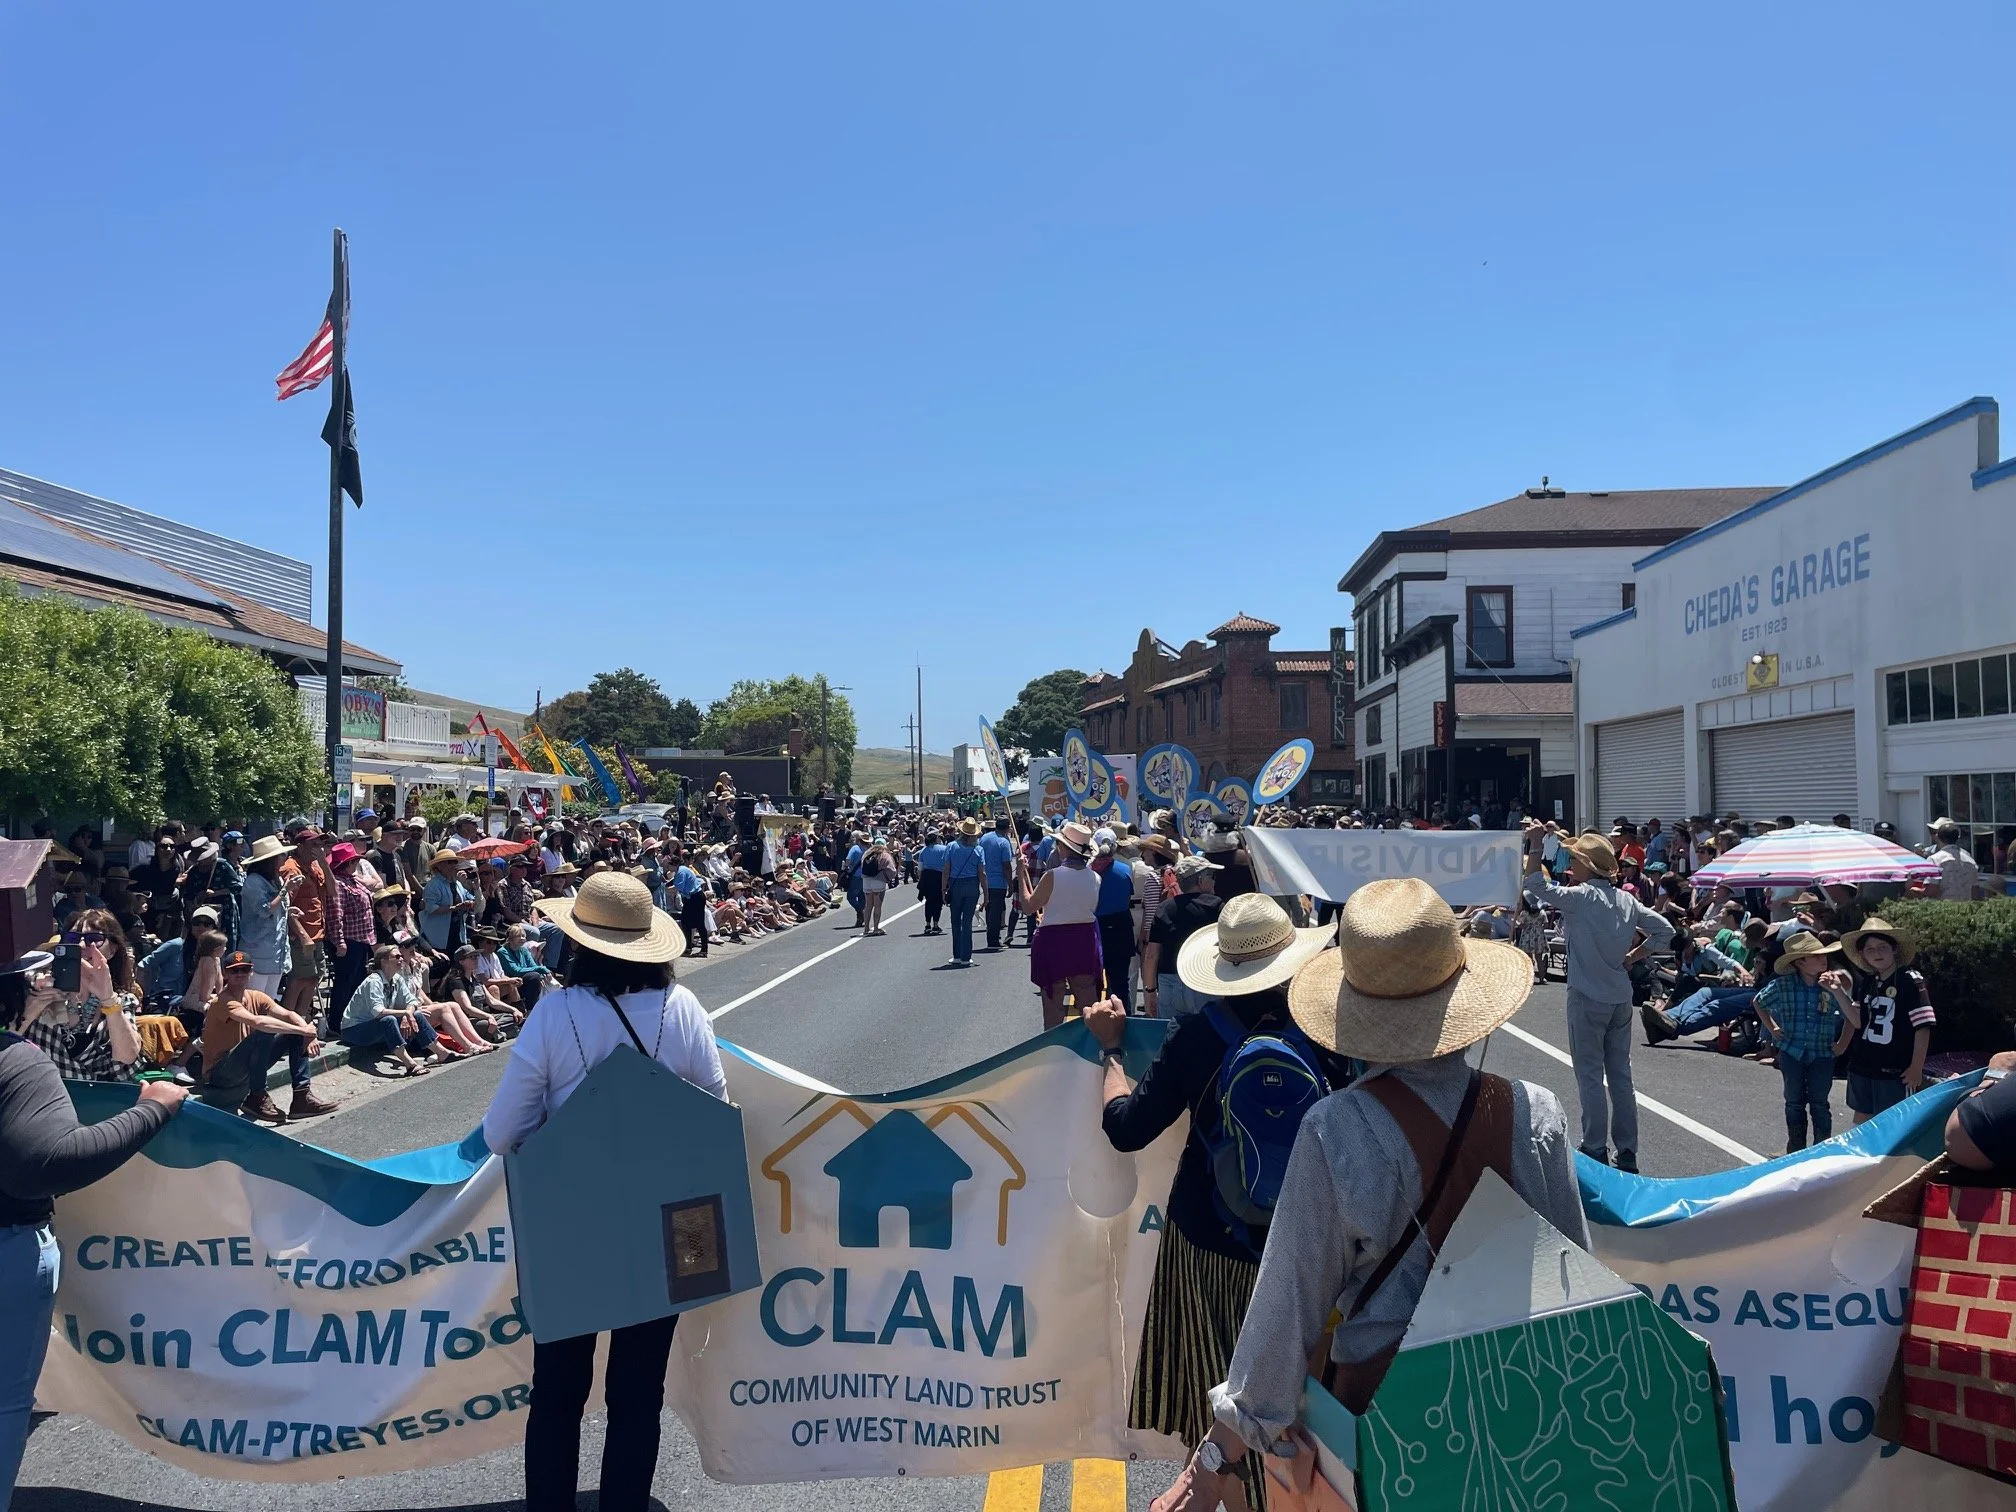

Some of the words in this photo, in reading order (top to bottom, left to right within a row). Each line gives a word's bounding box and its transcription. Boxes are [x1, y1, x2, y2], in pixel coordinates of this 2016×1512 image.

[1684, 574, 1760, 635] CHEDA'S
[1771, 533, 1870, 607] GARAGE
[1332, 636, 1345, 740] WESTERN
[1712, 671, 1745, 689] OLDEST
[1782, 660, 1792, 674] IN
[342, 692, 381, 717] OBY'S
[336, 746, 343, 756] 15
[77, 1235, 254, 1271] CREATE
[265, 1227, 506, 1291] FFORDABLE
[760, 1266, 1028, 1359] CLAM
[1734, 1287, 1910, 1331] ASEQU
[218, 1308, 407, 1367] CLAM
[729, 1373, 899, 1407] COMMUNITY
[905, 1376, 974, 1409] LAND
[980, 1378, 1062, 1410] TRUST
[1770, 1375, 1902, 1458] ho
[791, 1418, 829, 1447] OF
[836, 1416, 908, 1444] WEST
[914, 1420, 1000, 1448] MARIN
